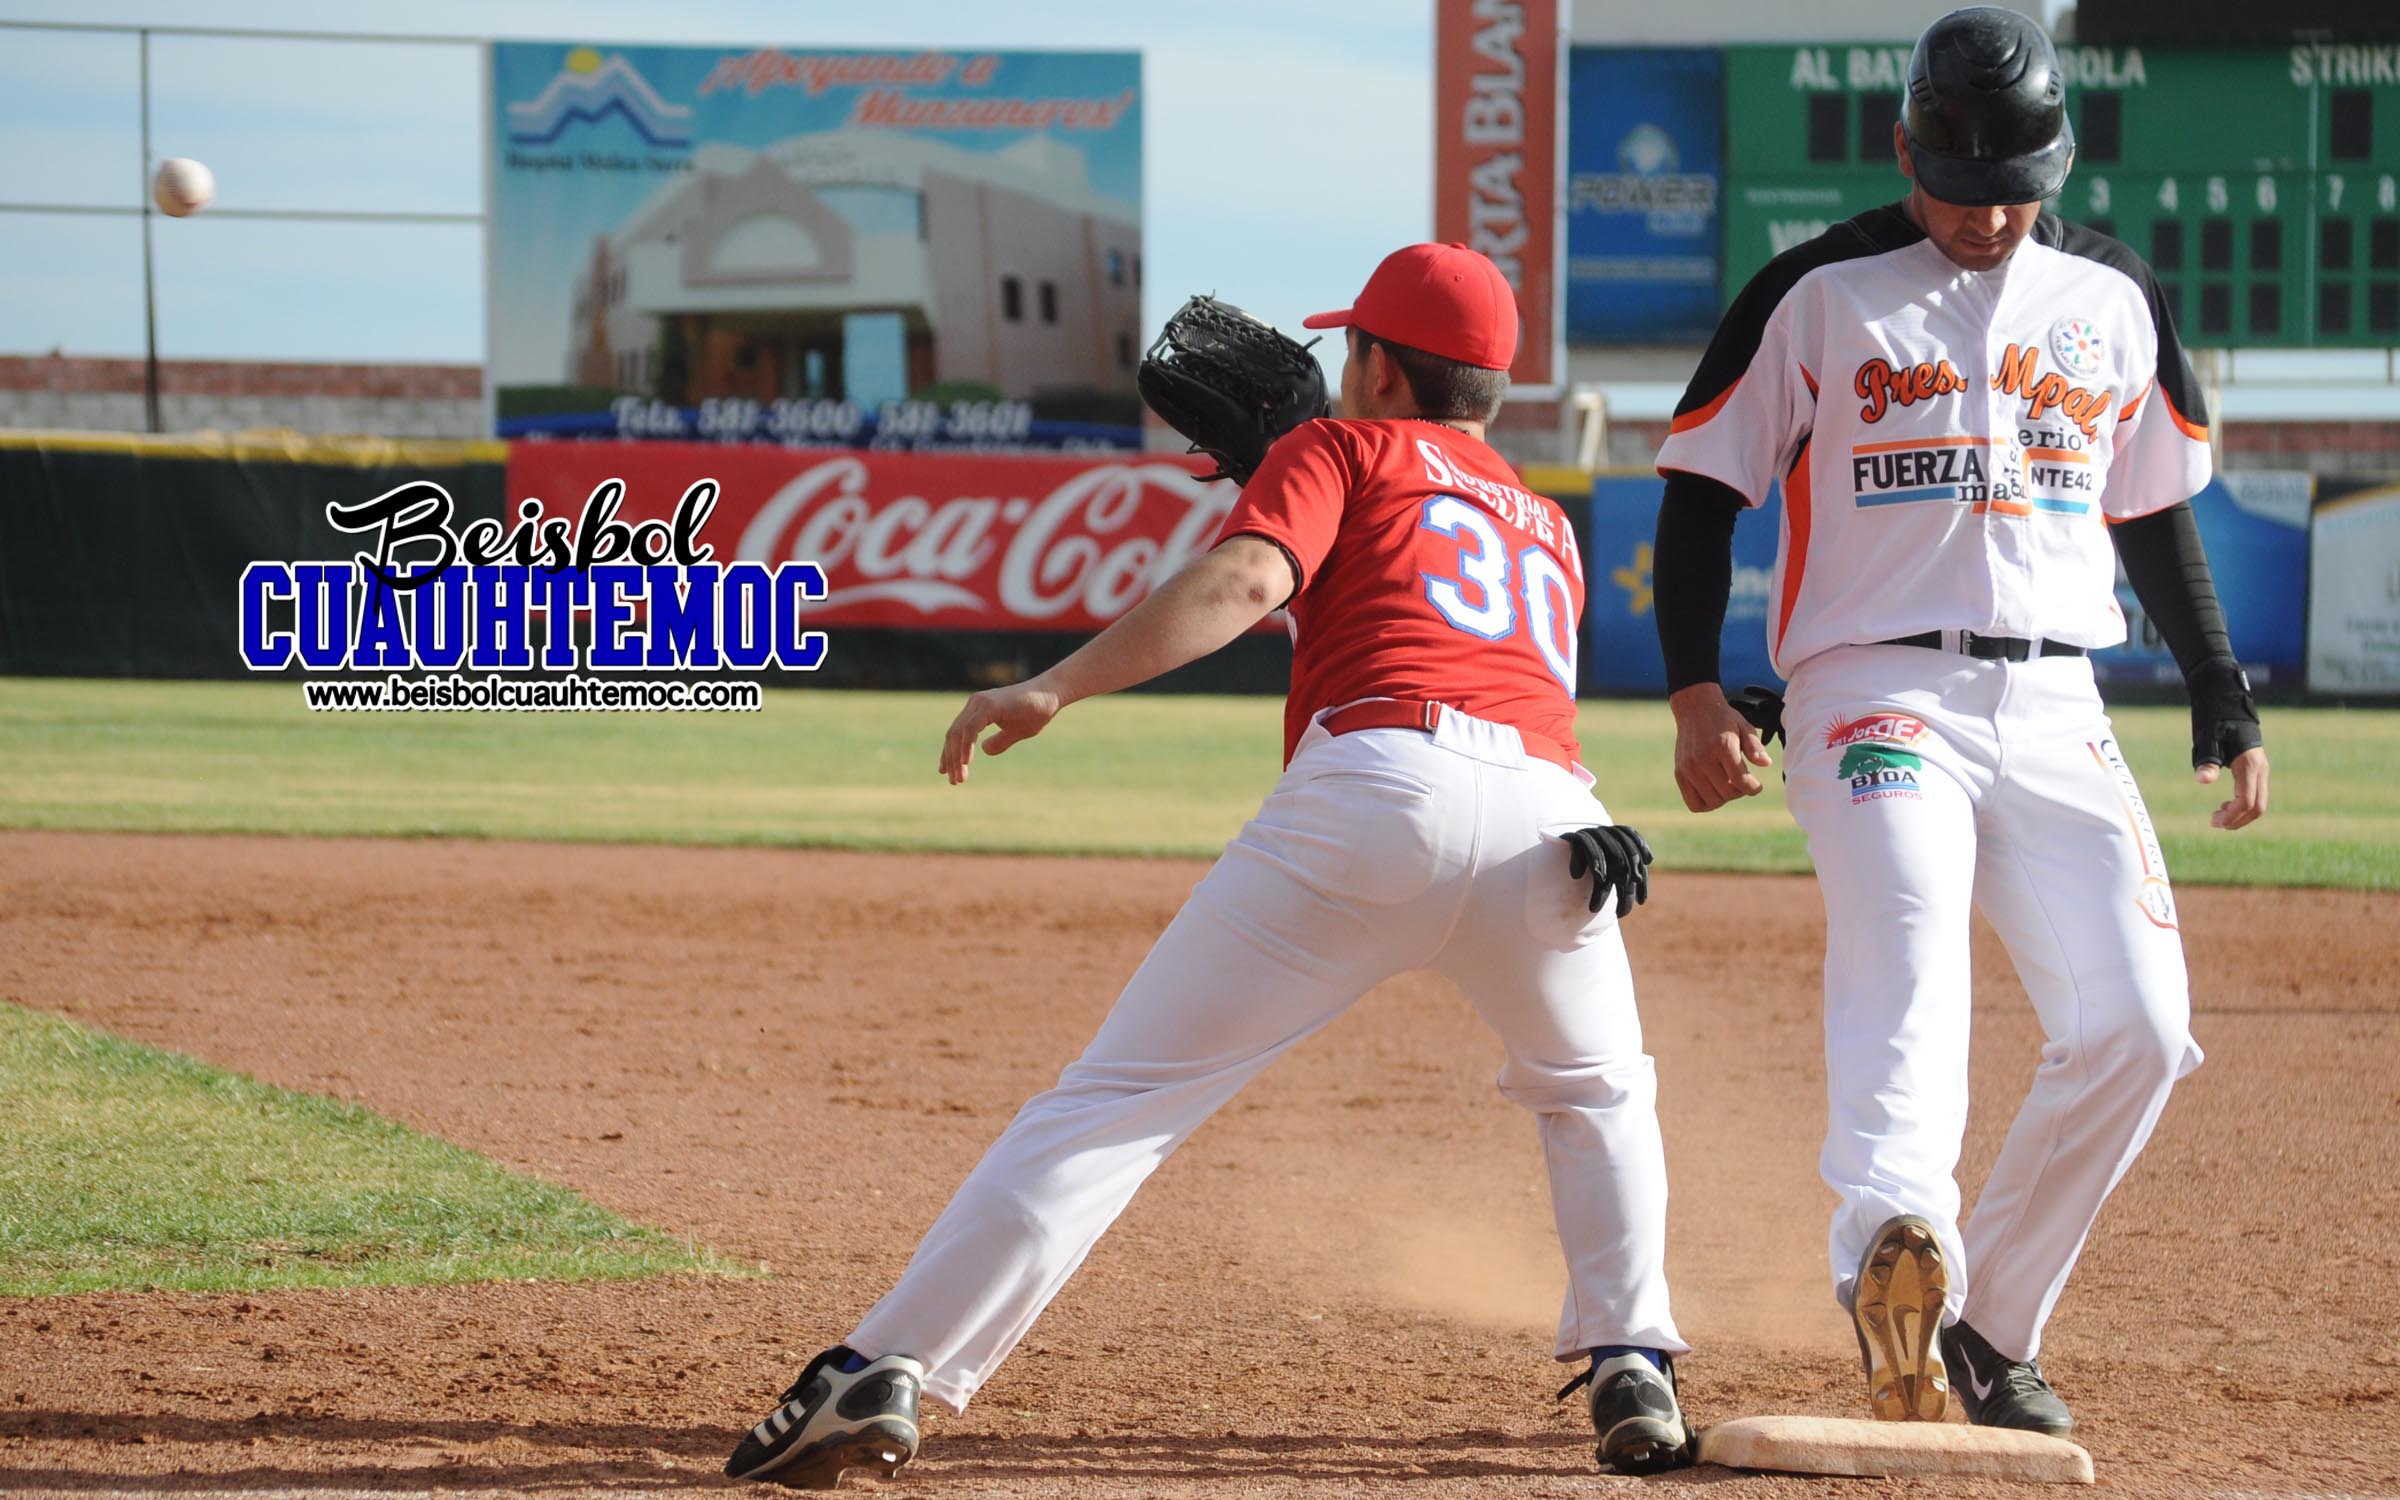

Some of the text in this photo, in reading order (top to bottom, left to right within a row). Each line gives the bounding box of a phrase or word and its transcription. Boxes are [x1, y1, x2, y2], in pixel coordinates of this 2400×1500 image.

[1789, 48, 1912, 90] AL BAT
[2058, 48, 2147, 89] BOLA
[2290, 44, 2400, 87] STRIK
[2088, 177, 2110, 214] 3
[2158, 177, 2179, 213] 4
[2207, 176, 2228, 213] 5
[2256, 175, 2277, 213] 6
[2325, 174, 2345, 212] 7
[1853, 448, 2094, 492] FUERZA NTE42
[736, 457, 1243, 620] Coca-Col
[1418, 493, 1578, 701] 30
[1851, 790, 1923, 806] SEGUROS
